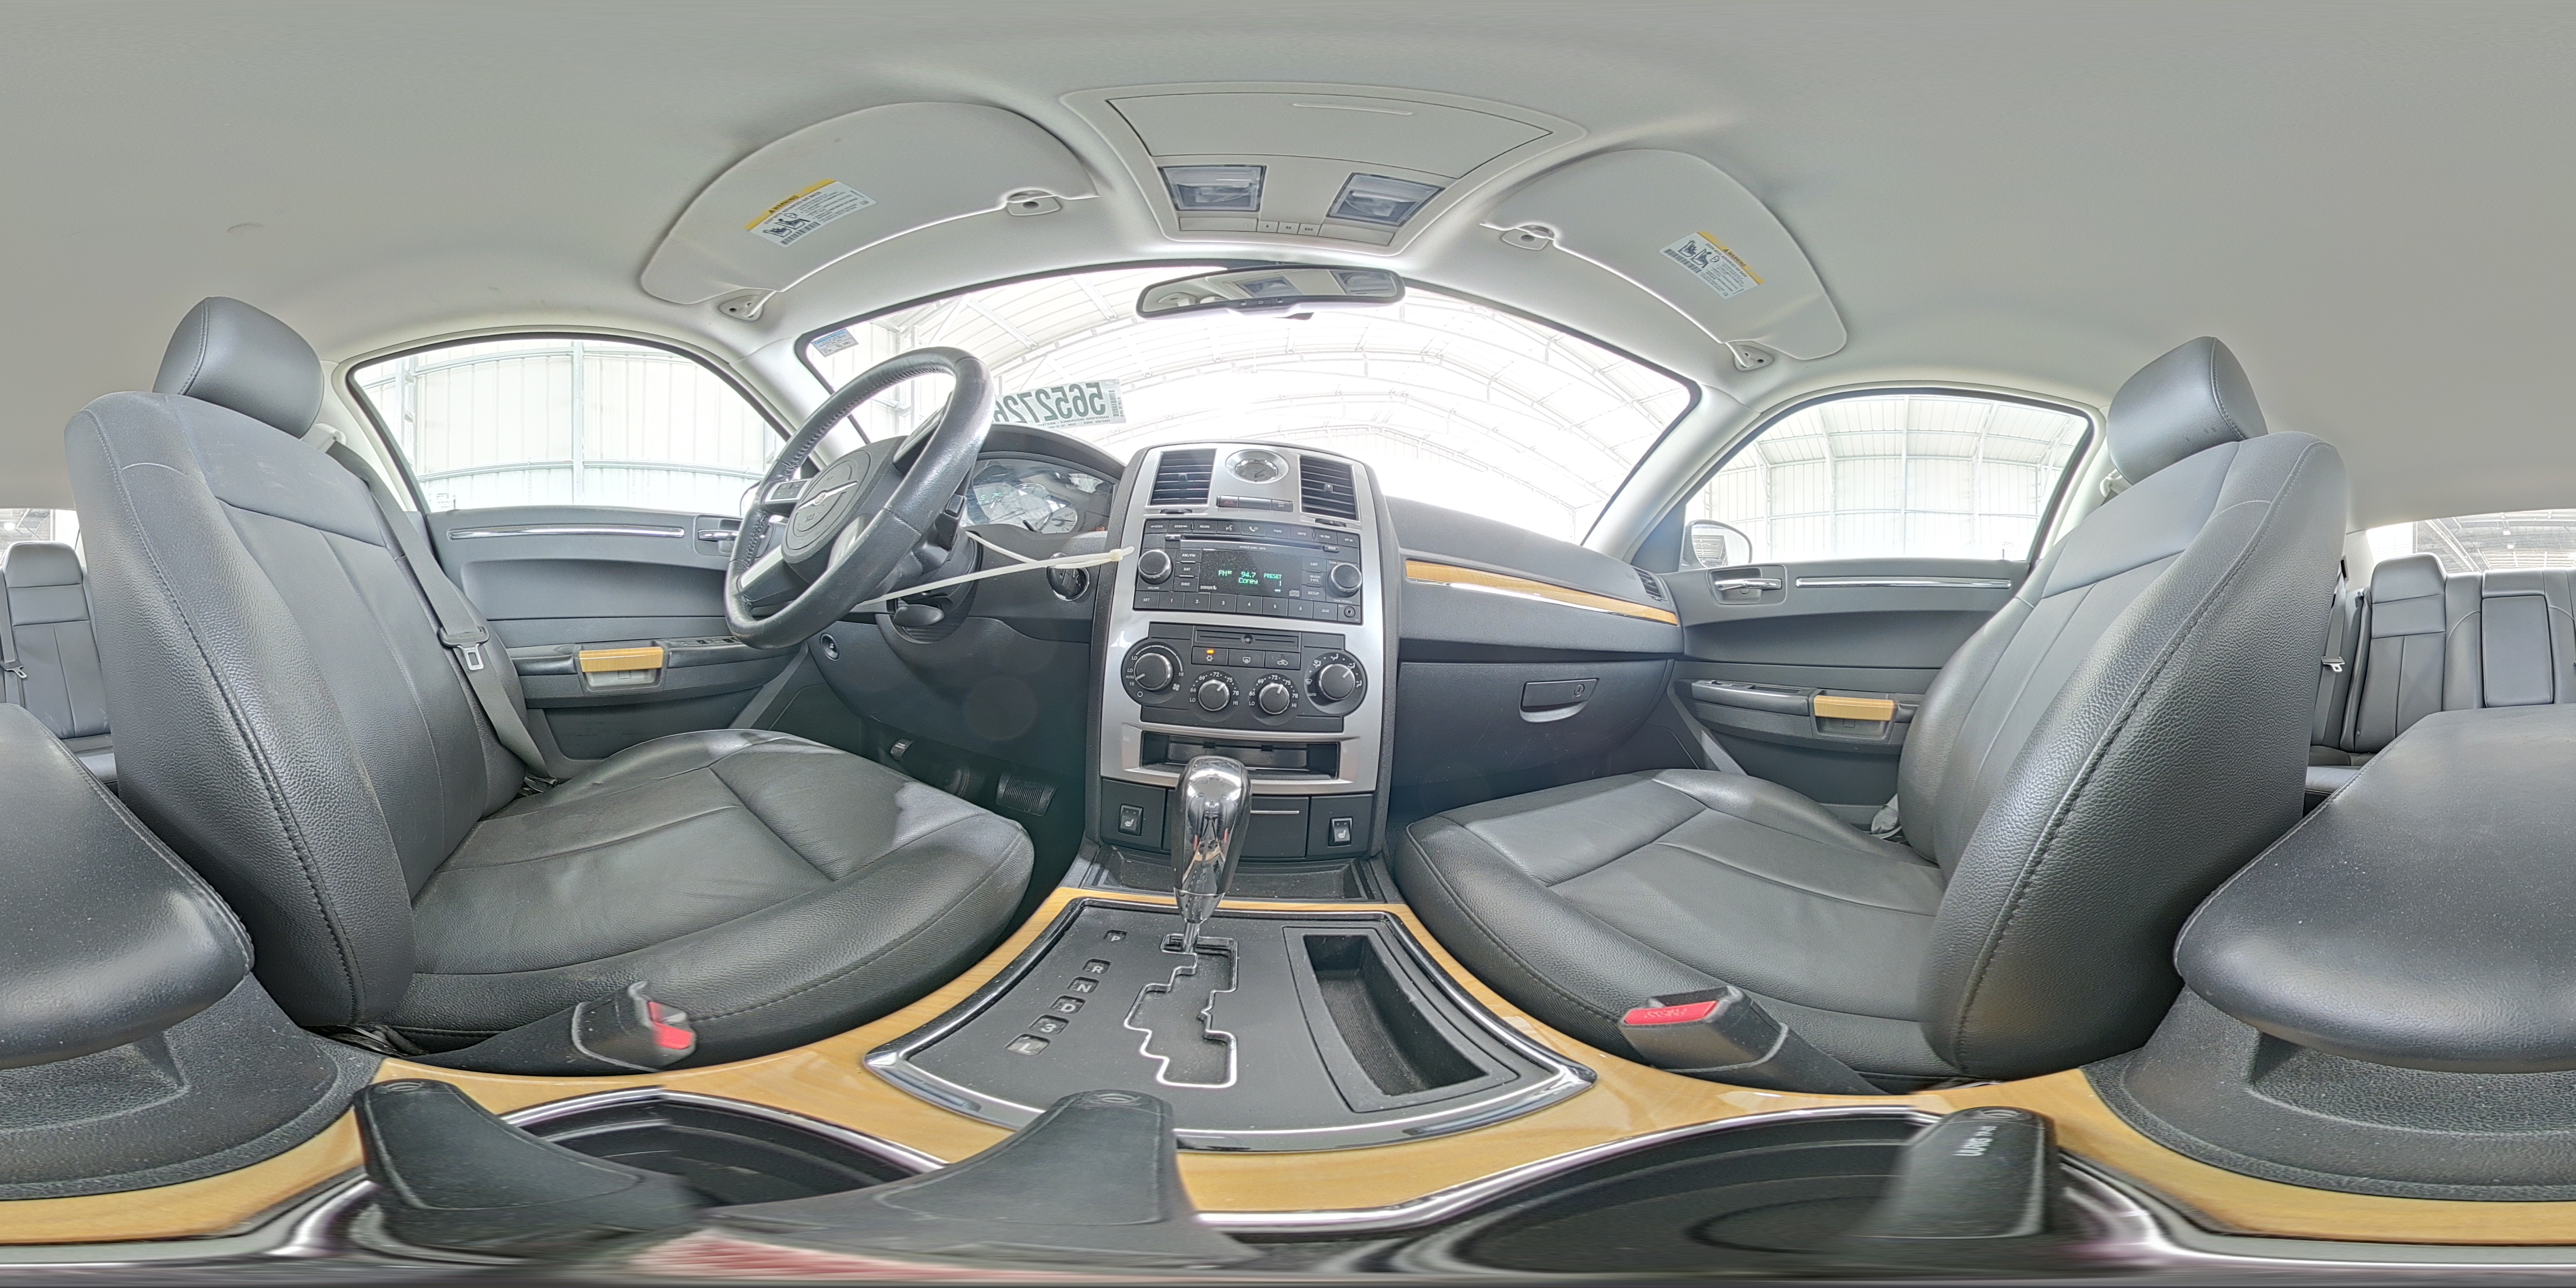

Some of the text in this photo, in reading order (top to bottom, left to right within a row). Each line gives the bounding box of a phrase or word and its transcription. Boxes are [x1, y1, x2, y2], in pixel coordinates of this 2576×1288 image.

[772, 195, 799, 210] WARNING
[1727, 252, 1747, 267] WARNING
[1076, 984, 1092, 993] N
[1060, 1003, 1076, 1012] D
[1040, 1024, 1056, 1032] 3
[1018, 1043, 1031, 1053] L
